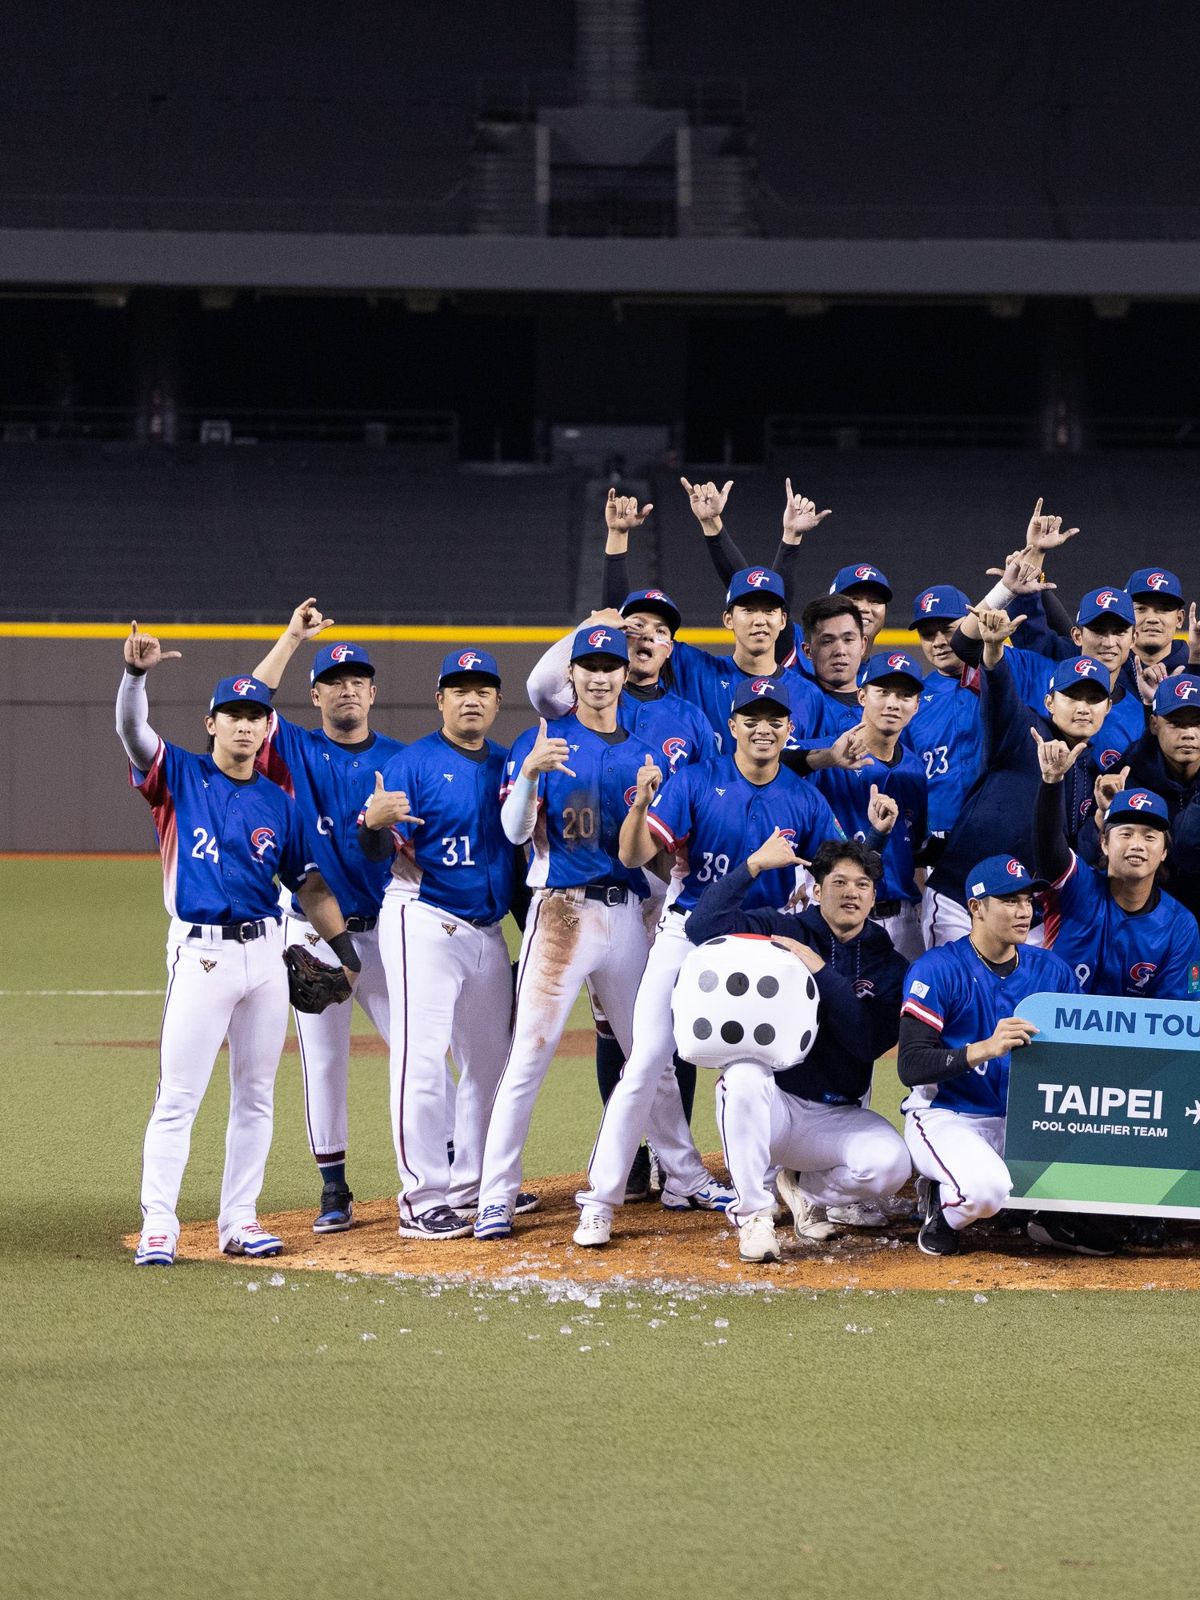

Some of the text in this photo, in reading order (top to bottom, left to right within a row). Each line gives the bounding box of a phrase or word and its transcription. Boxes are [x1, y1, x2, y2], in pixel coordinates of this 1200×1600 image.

[923, 745, 949, 779] 23
[562, 807, 594, 839] 20
[192, 827, 219, 864] 24
[441, 835, 475, 866] 31
[697, 852, 730, 883] 39
[1054, 1007, 1137, 1034] MAIN
[1038, 1083, 1163, 1120] TAIPEI
[1032, 1120, 1168, 1138] POOL QUALIFIER TEAM
